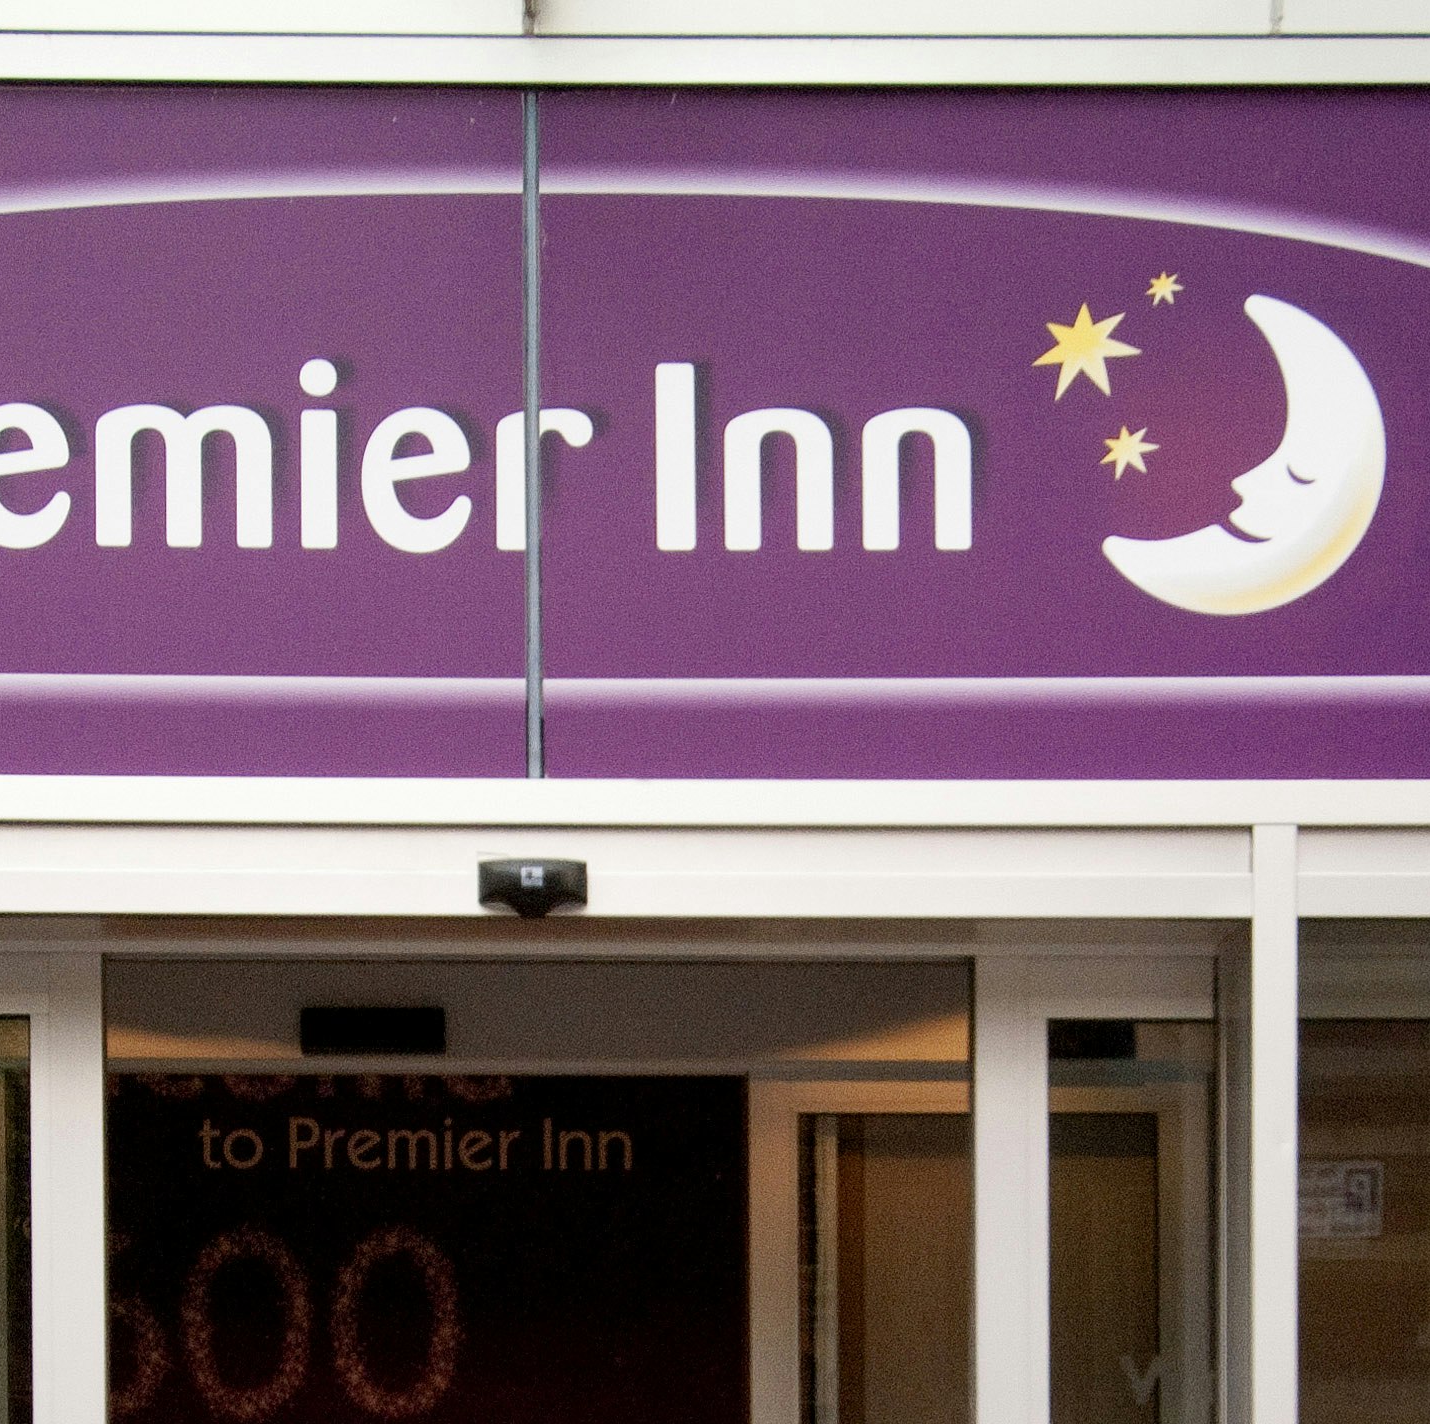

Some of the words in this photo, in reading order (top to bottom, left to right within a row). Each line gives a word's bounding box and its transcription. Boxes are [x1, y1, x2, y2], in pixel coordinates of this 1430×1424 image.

[655, 362, 973, 552] Inn
[198, 1117, 265, 1170] to
[288, 1115, 521, 1171] Premier
[542, 1117, 633, 1171] Inn
